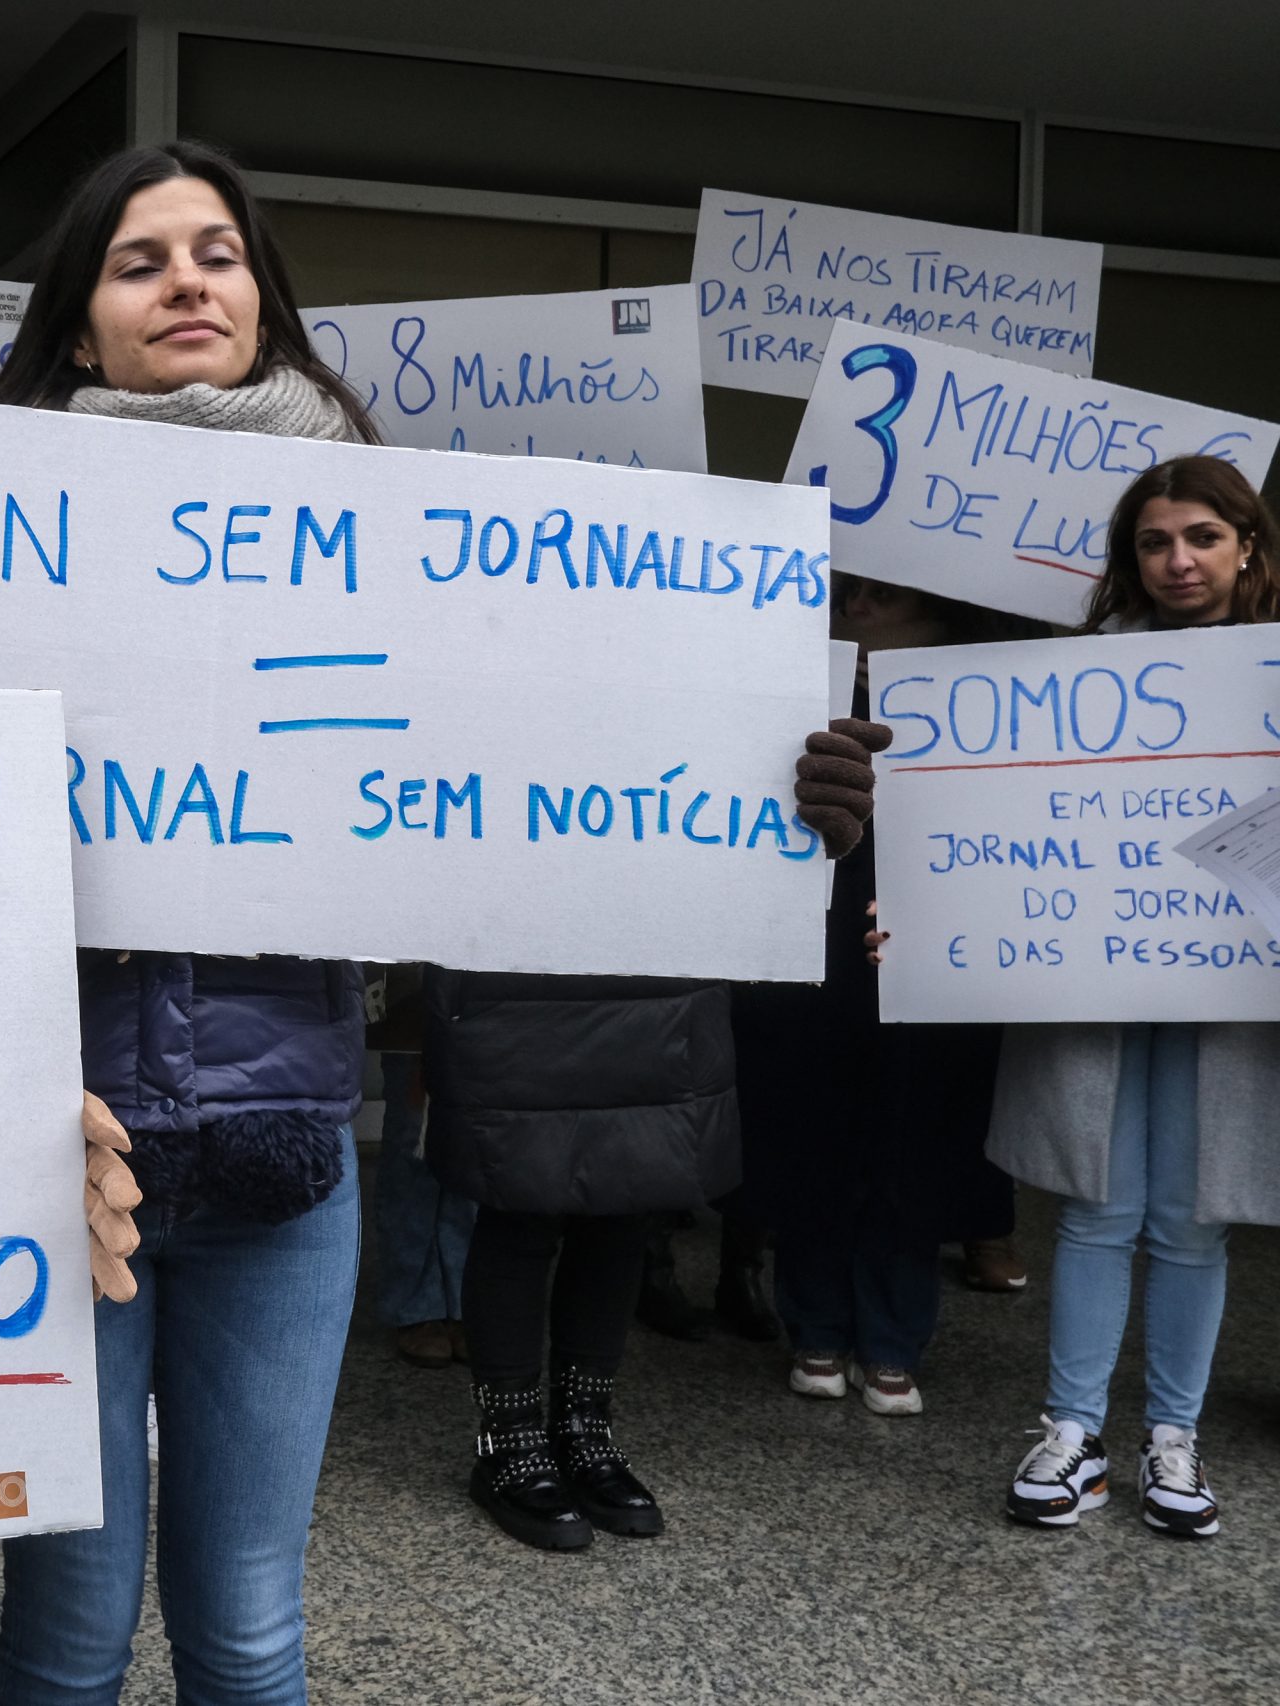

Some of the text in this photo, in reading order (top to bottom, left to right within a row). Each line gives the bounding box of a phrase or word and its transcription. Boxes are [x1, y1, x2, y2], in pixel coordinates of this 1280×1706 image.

[723, 207, 798, 274] JÁ
[816, 245, 892, 286] NOS
[6, 293, 21, 302] dar
[618, 301, 649, 325] JN
[700, 279, 747, 318] DA
[991, 314, 1093, 363] QUEREM
[808, 343, 919, 526] 3
[922, 370, 1164, 476] MILHÕES
[154, 499, 360, 597] SEM
[419, 505, 828, 611] JORNALISTAS
[909, 472, 1108, 560] DE LUC
[878, 661, 1188, 758] SOMOS
[66, 744, 820, 863] RNAL SEM NOTÍCIAS
[1048, 786, 1238, 822] EM DEFESA
[927, 831, 1163, 874] JORNAL DE
[1023, 886, 1255, 921] DO JORNA
[948, 934, 1280, 969] E DAS PESSOAS
